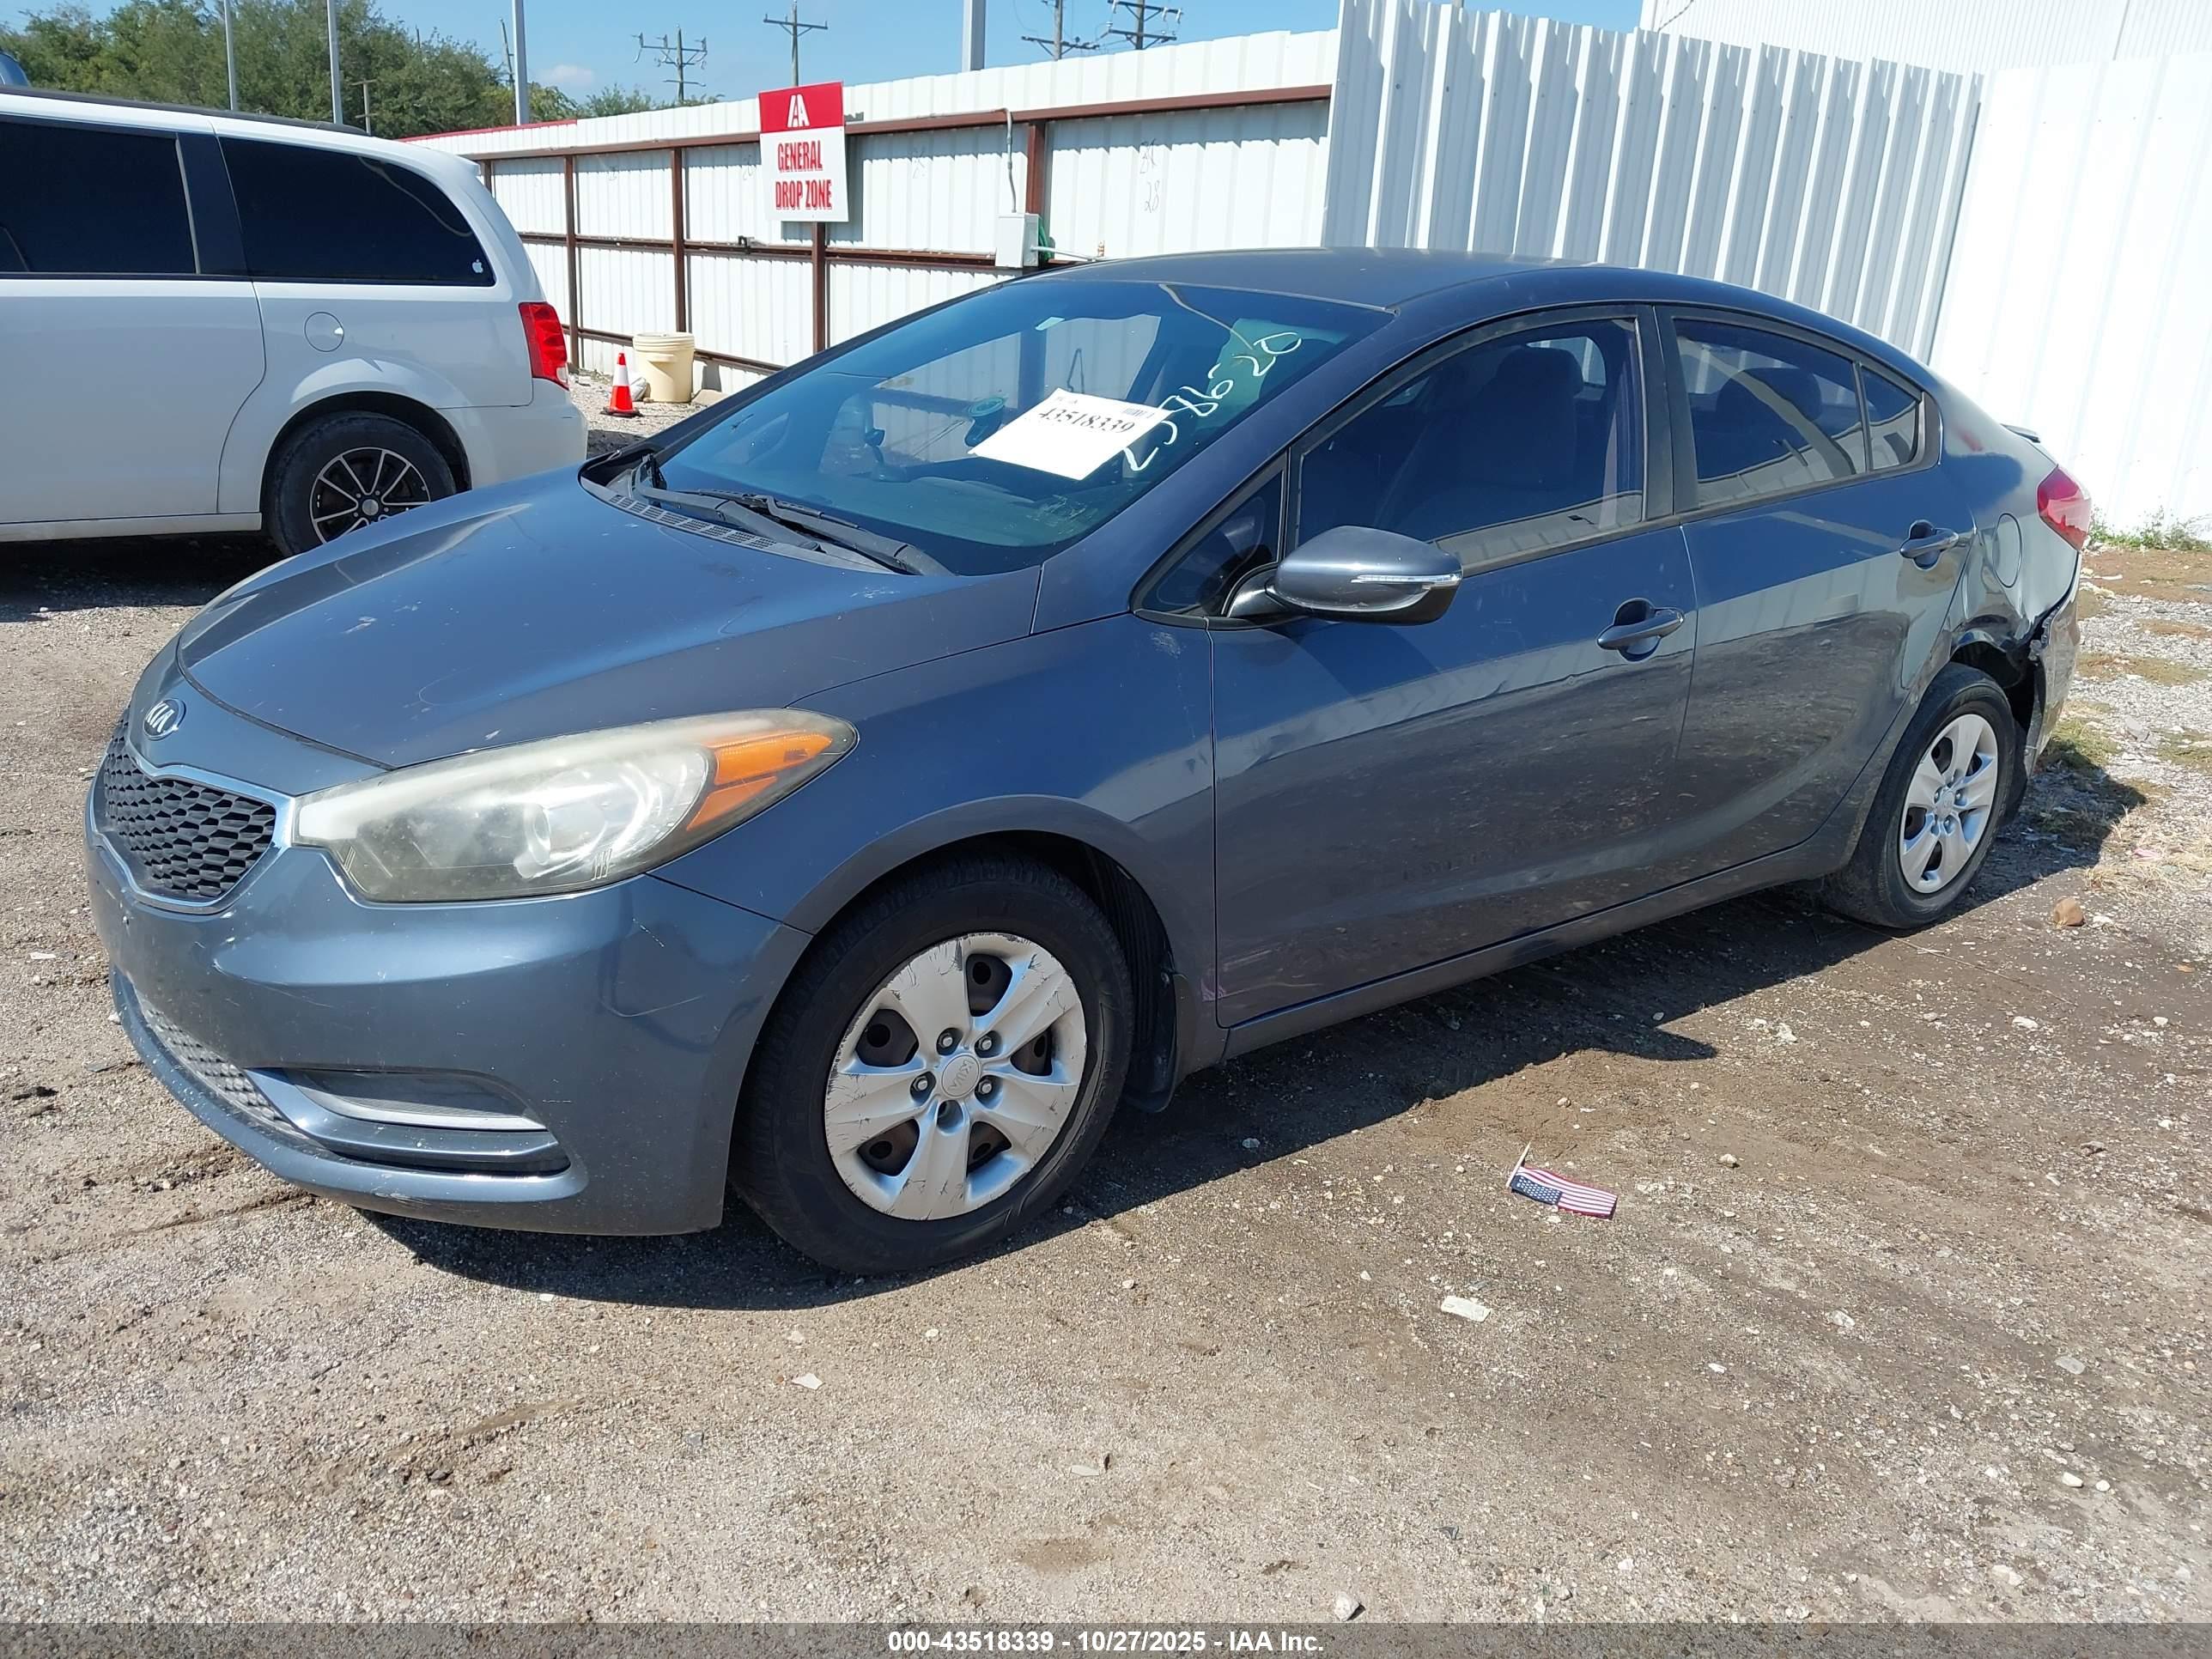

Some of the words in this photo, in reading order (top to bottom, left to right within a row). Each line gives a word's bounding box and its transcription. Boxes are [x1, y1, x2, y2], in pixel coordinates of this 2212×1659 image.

[777, 140, 823, 172] GENERAL
[775, 180, 803, 210] DROP
[805, 179, 833, 210] ZONE
[1038, 407, 1136, 434] 43518339
[147, 702, 175, 733] KIA
